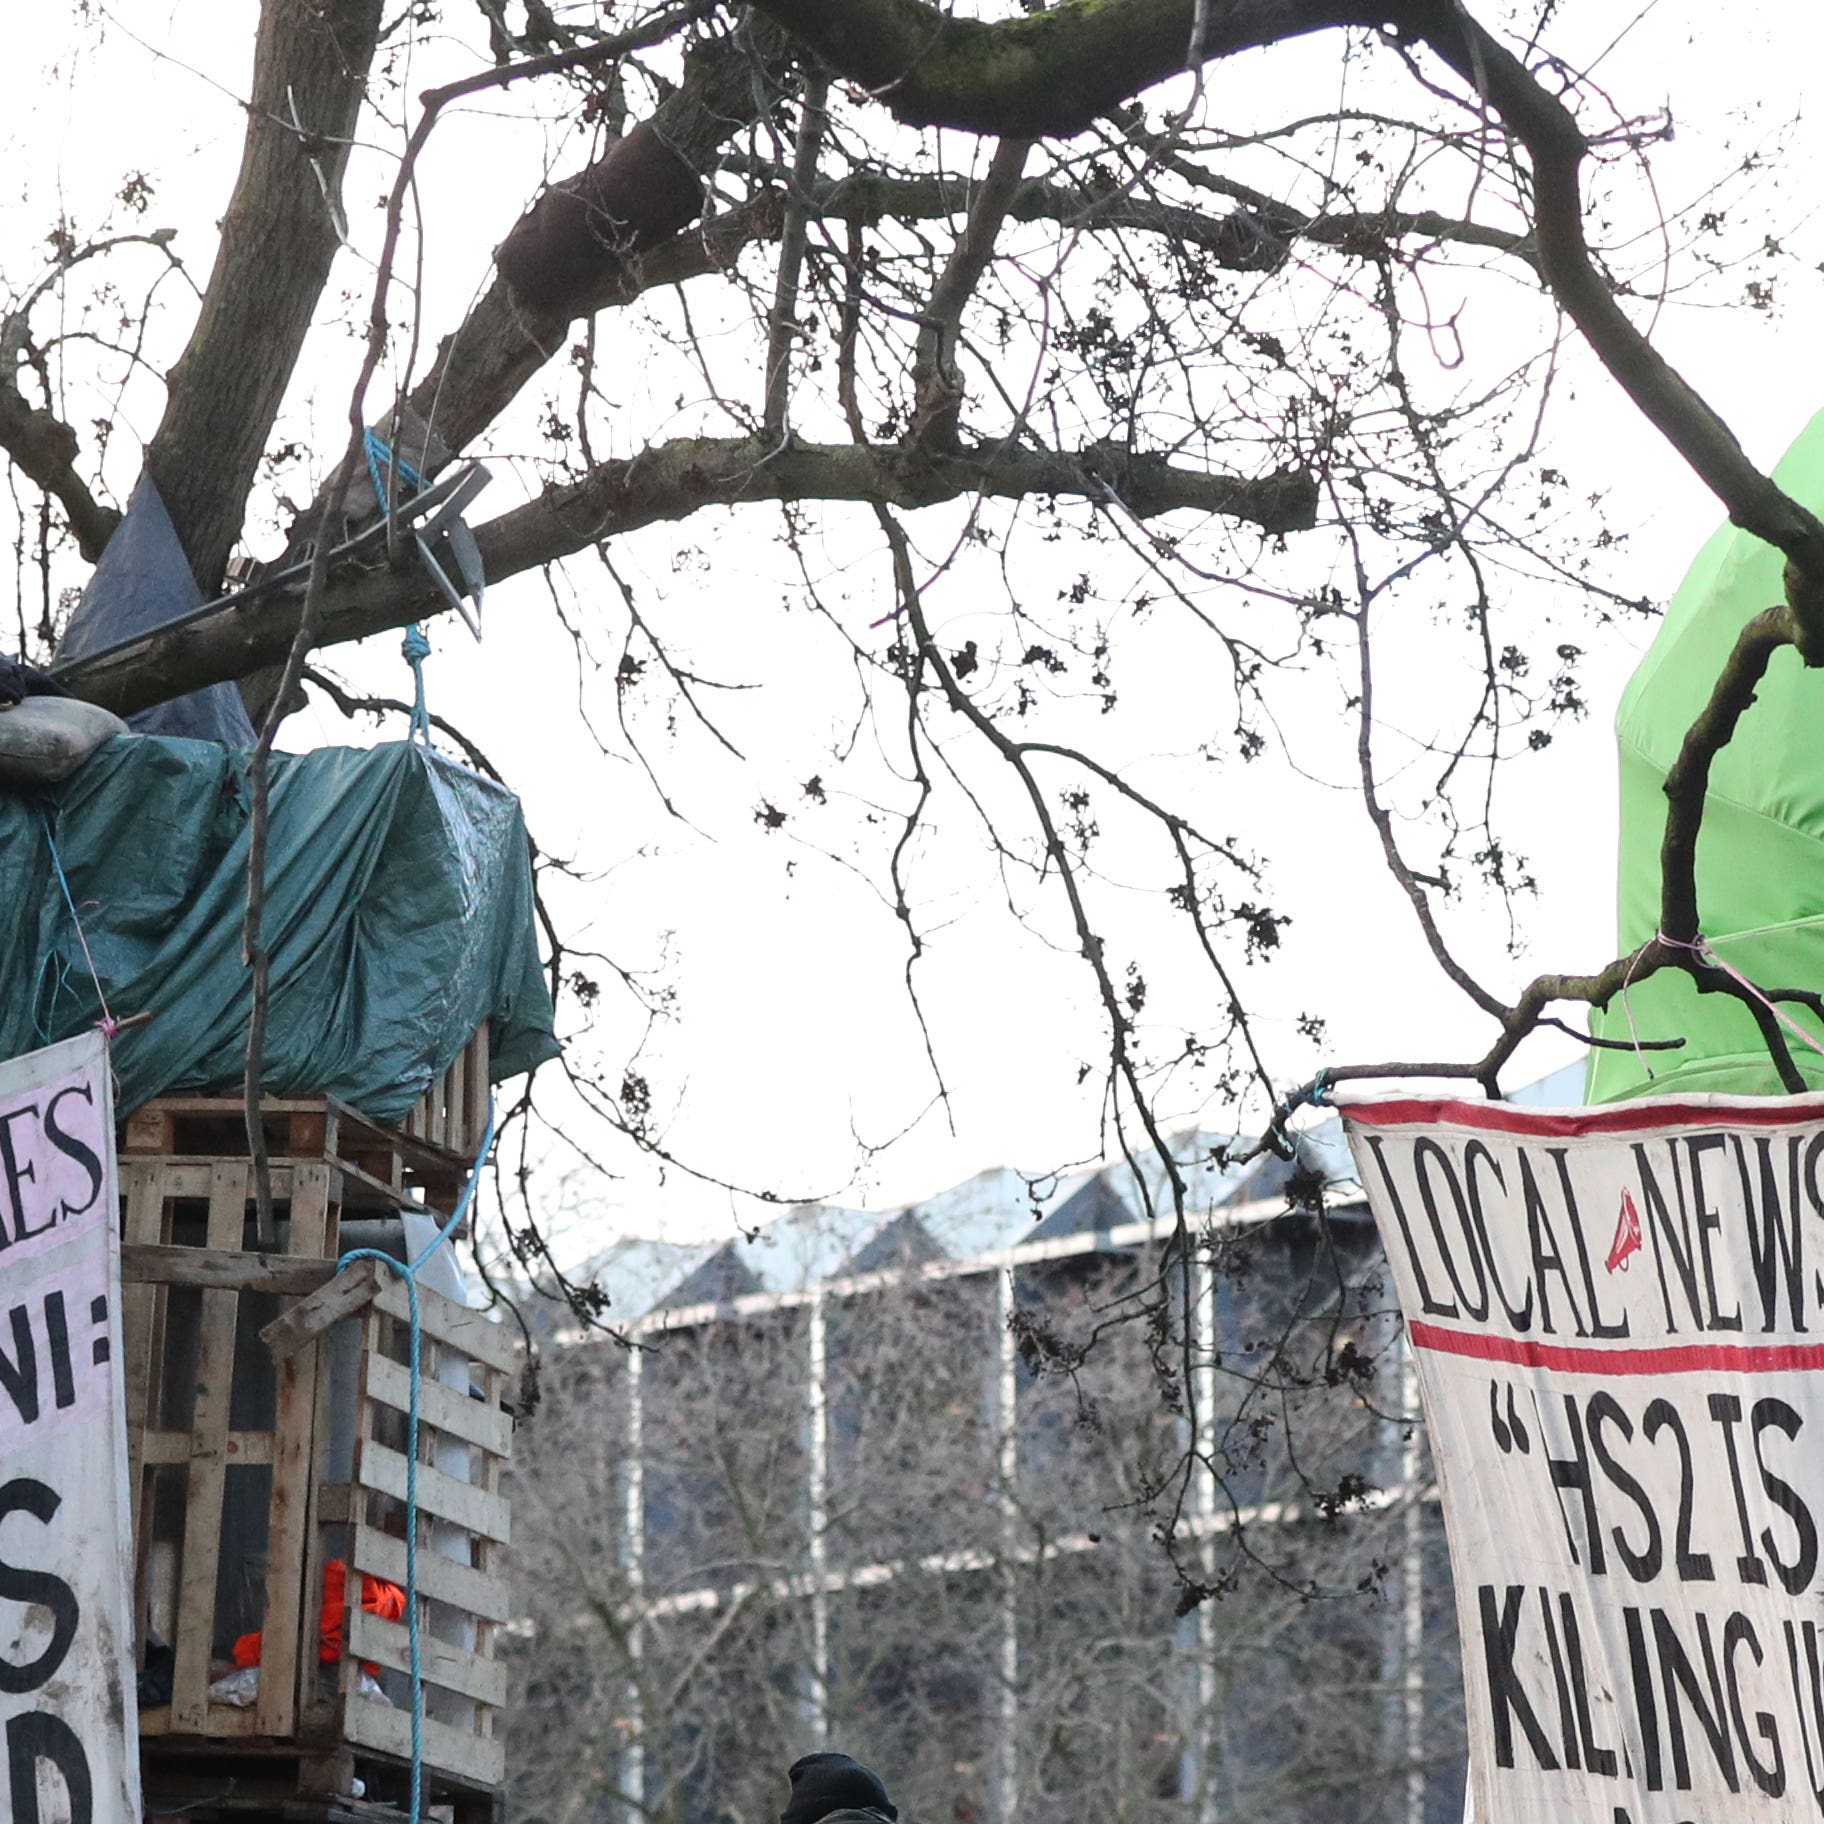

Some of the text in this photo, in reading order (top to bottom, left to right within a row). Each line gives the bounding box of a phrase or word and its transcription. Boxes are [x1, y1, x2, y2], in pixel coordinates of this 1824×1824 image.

[1364, 1134, 1630, 1338] LOCAL
[1707, 1392, 1819, 1597] IS
[1478, 1584, 1787, 1800] KILING
